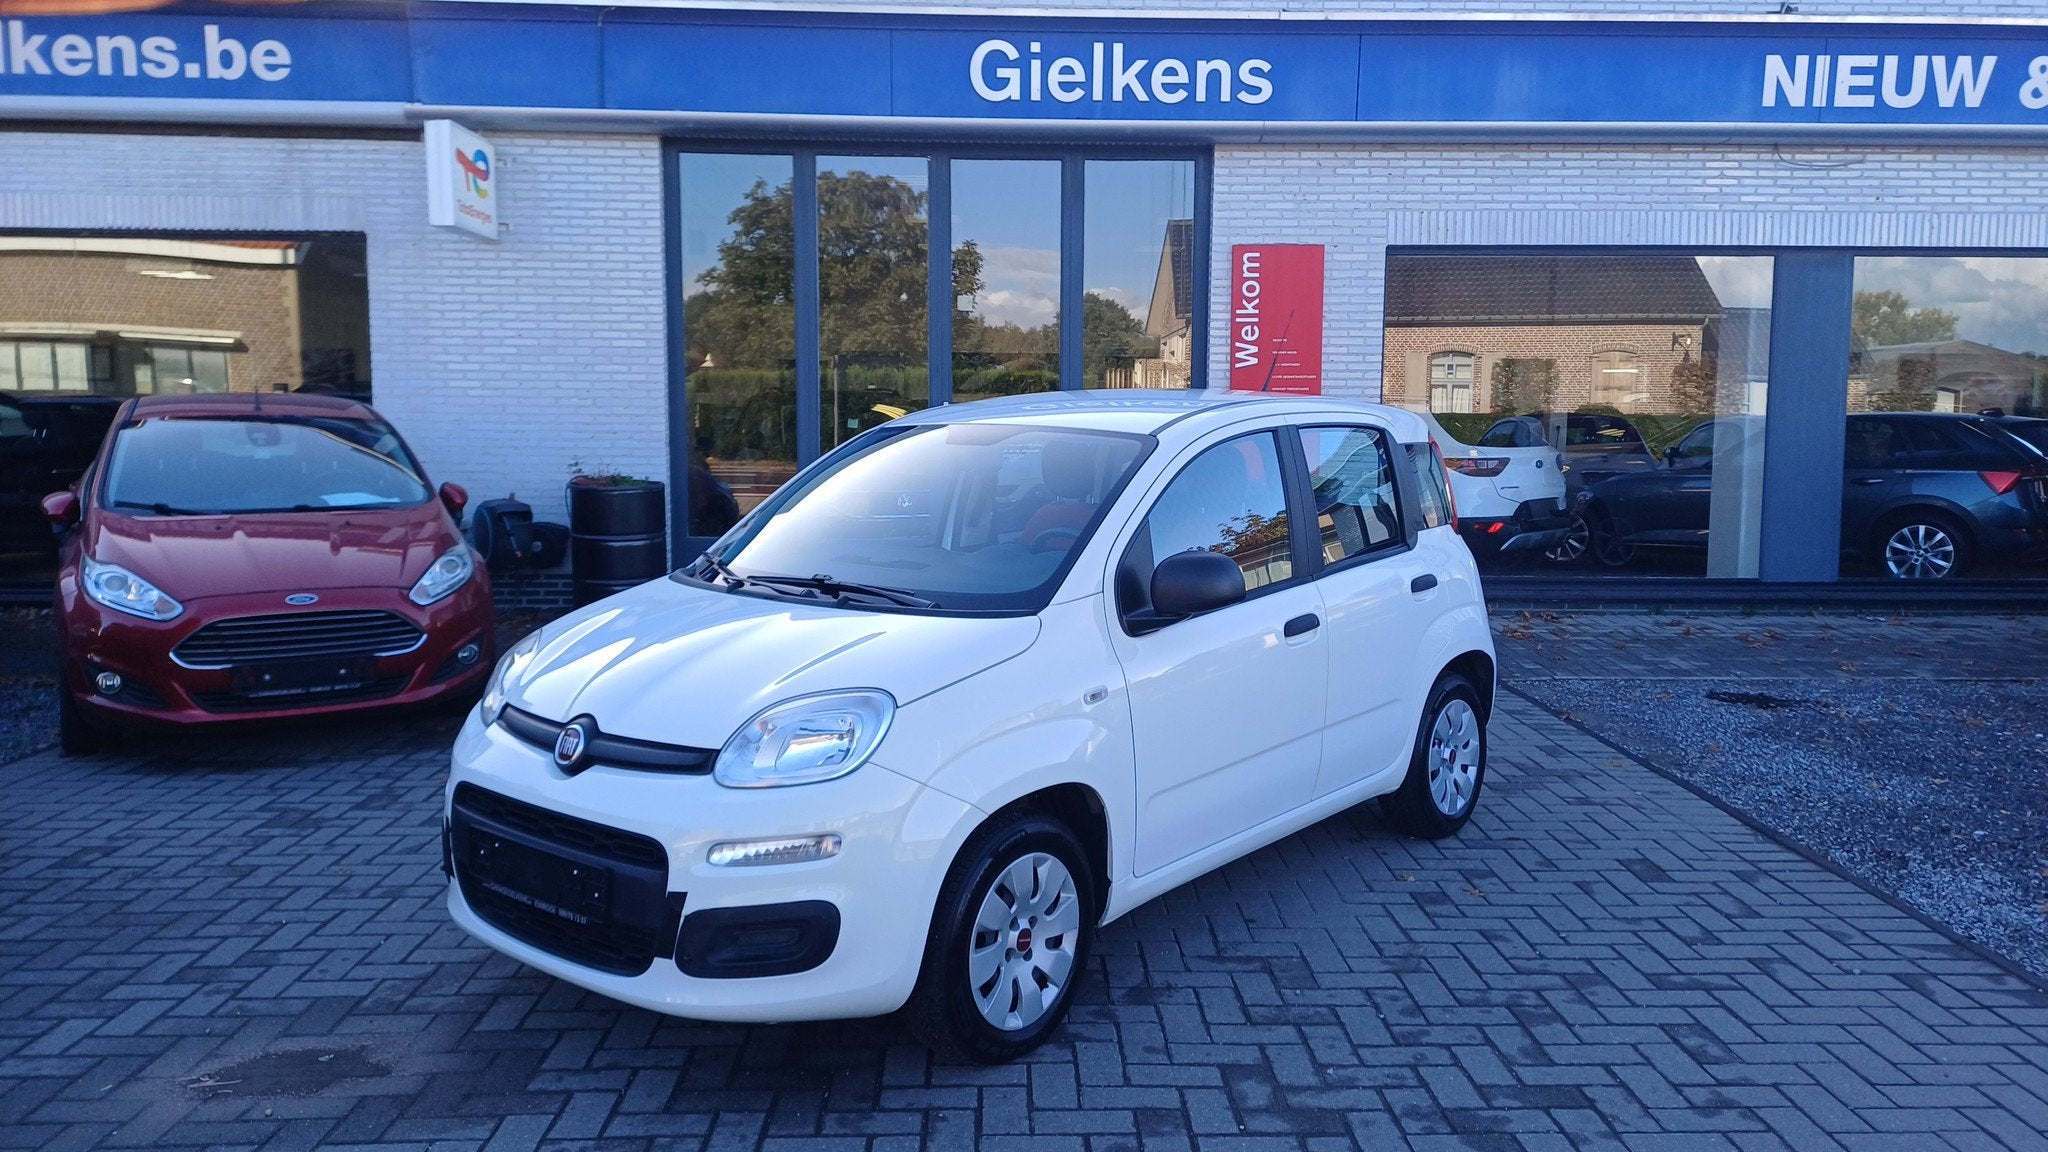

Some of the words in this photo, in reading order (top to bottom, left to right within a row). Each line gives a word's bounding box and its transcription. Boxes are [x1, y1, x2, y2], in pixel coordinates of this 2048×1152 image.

[969, 39, 1275, 104] Gielkens
[1762, 54, 1998, 108] NIEUW
[1234, 251, 1261, 369] Welkom
[559, 735, 579, 757] FIAT
